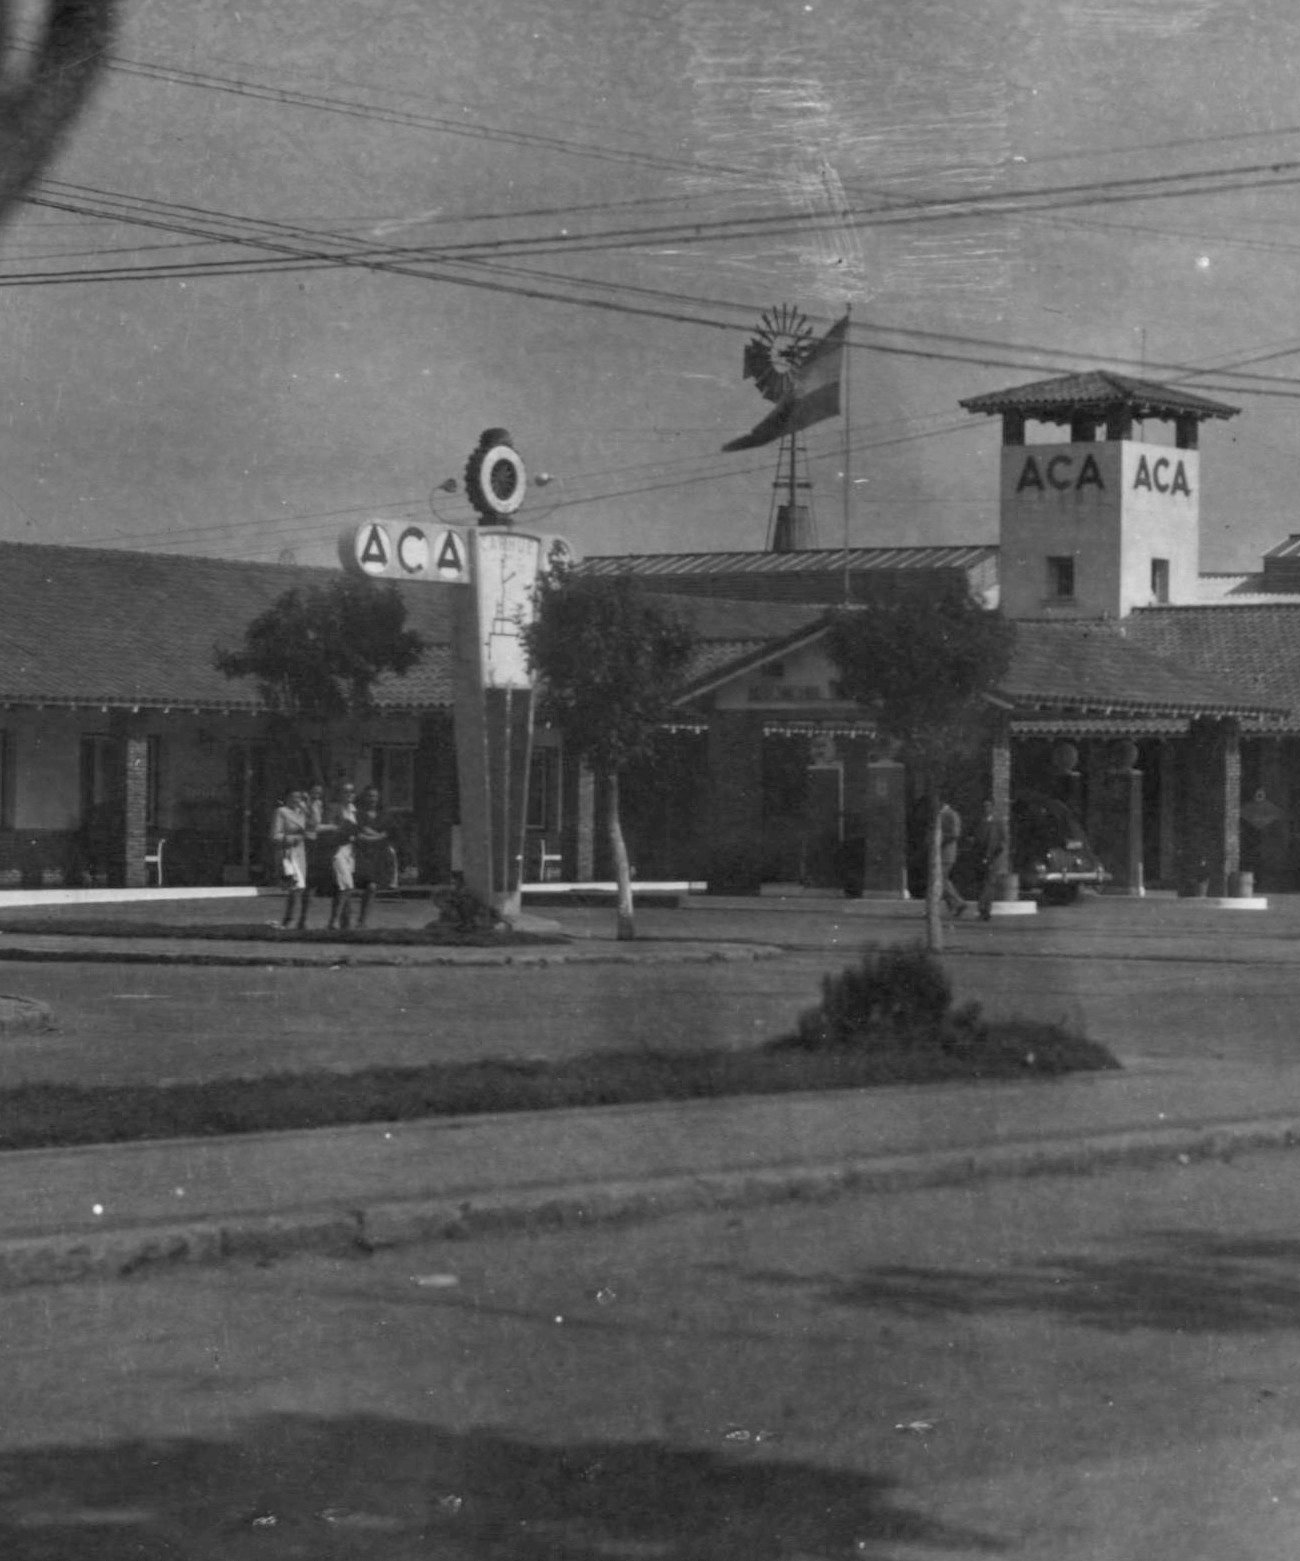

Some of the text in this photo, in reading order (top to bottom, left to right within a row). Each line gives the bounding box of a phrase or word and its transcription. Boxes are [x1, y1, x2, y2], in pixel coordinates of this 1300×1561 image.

[1016, 453, 1105, 493] ACA
[1133, 454, 1192, 498] ACA
[361, 522, 462, 575] ACA
